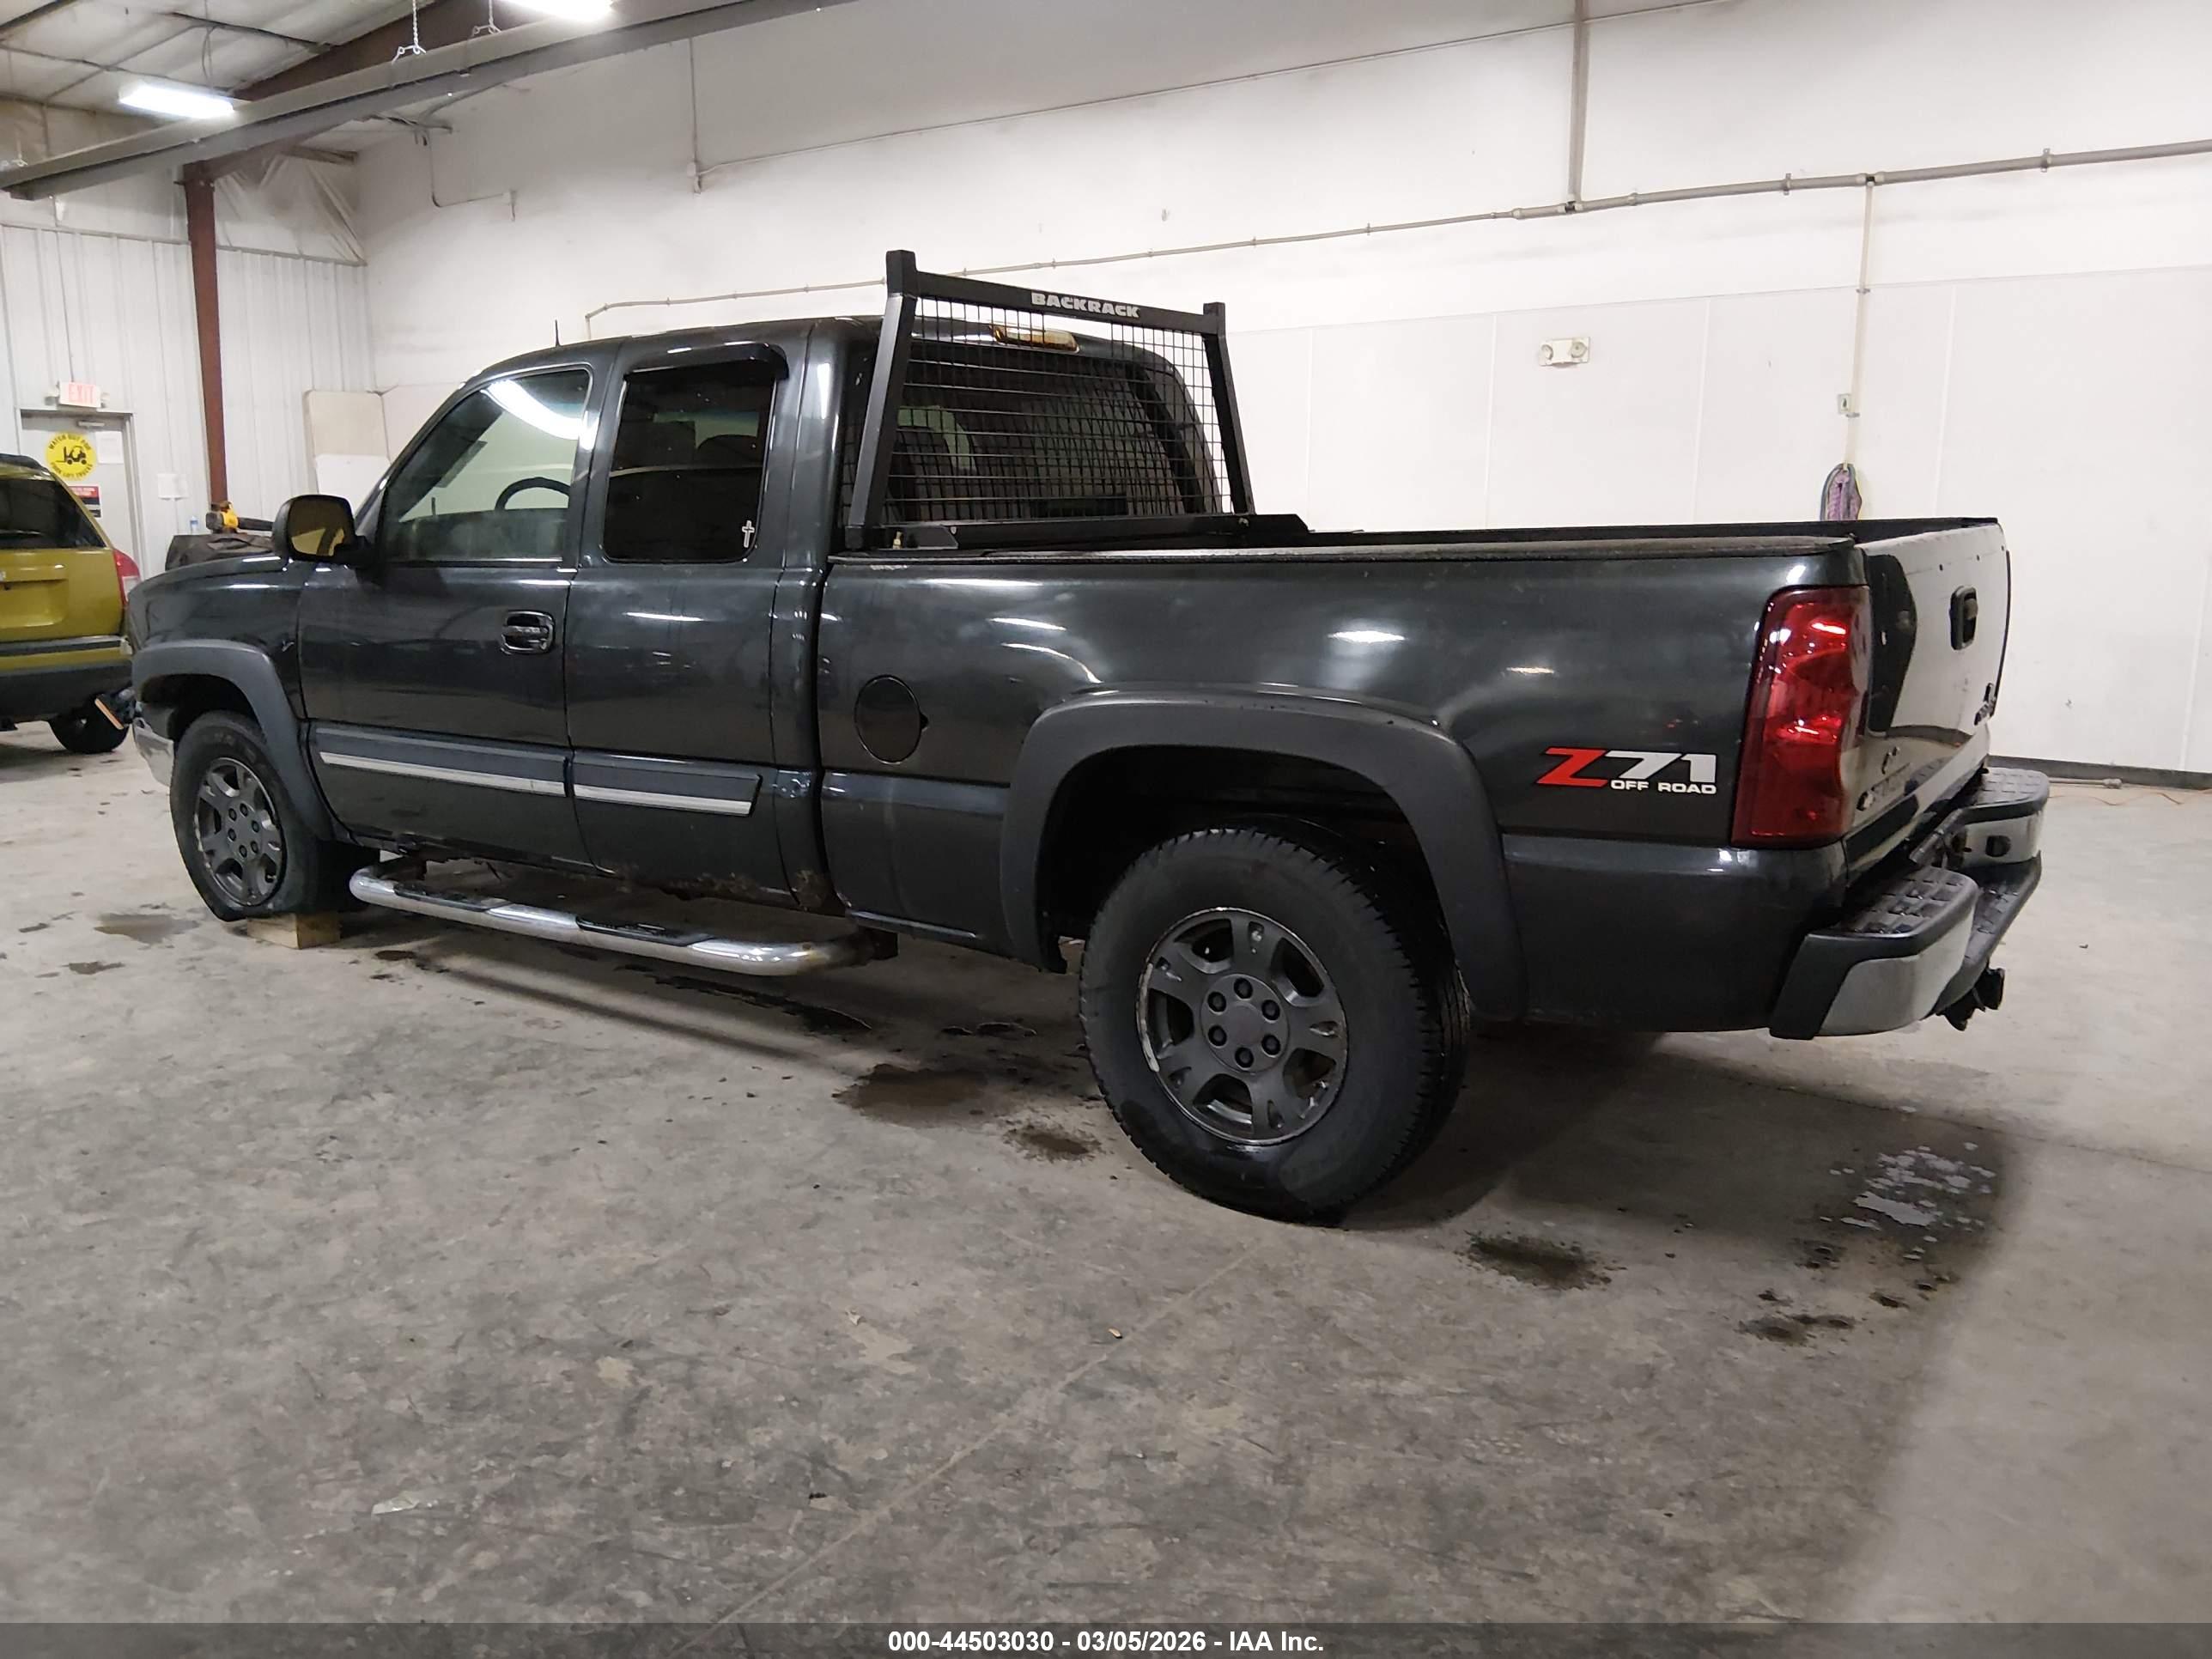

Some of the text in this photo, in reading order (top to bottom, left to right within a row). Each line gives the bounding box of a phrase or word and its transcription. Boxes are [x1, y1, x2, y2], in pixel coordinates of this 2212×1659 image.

[1031, 292, 1140, 318] BACKRACK
[68, 383, 94, 404] EXIT
[1536, 747, 1717, 787] Z71
[1611, 780, 1717, 794] OFF ROAD
